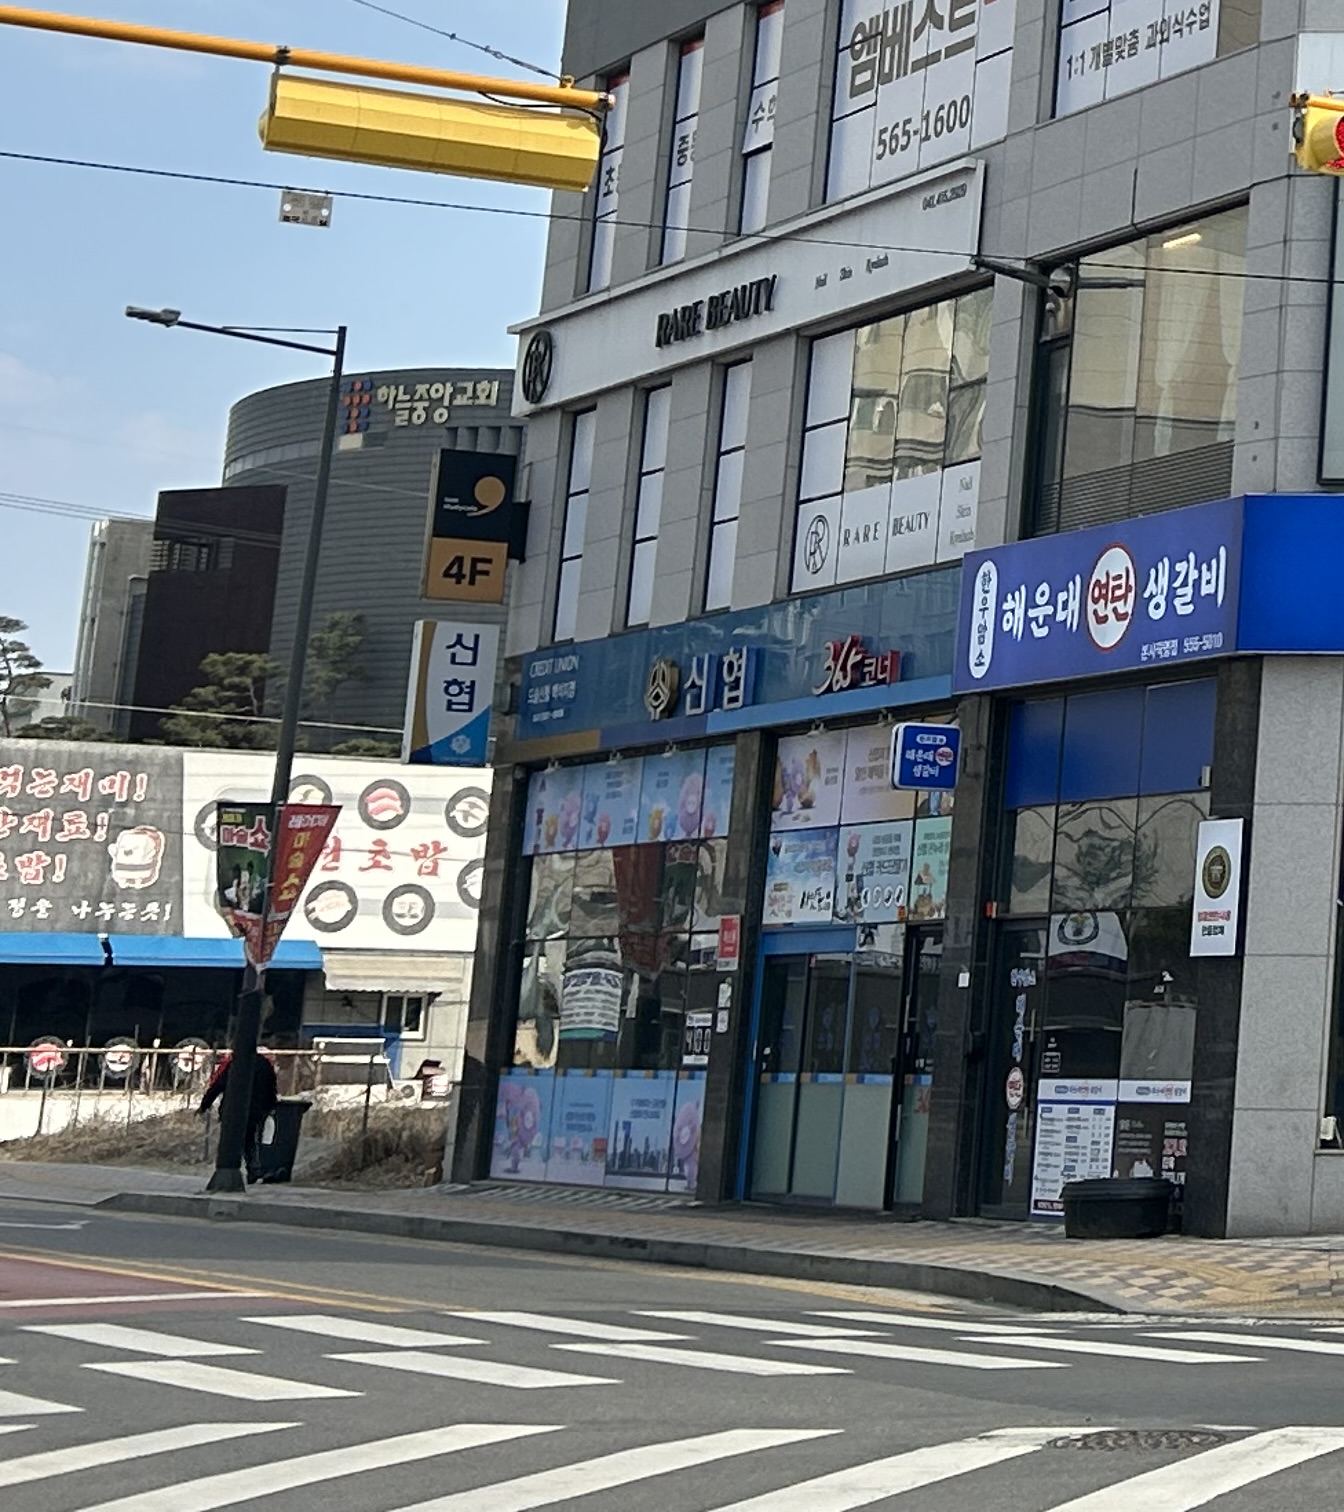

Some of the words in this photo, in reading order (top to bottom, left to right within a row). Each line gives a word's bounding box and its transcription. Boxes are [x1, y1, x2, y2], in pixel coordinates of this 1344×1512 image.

[1089, 28, 1140, 71] 개별맞춤
[1144, 0, 1212, 50] 과외식수업
[876, 94, 971, 161] 565-1600
[655, 299, 704, 348] RARE
[705, 274, 778, 332] BEAUTY
[377, 380, 500, 426] 하늘중앙교회
[842, 521, 881, 547] RARE
[892, 511, 930, 537] BEAUTY
[441, 556, 493, 587] 4F
[973, 570, 994, 668] 한우암소
[1001, 573, 1082, 642] 해운대
[1090, 567, 1133, 625] 연탄
[1143, 545, 1227, 621] 생갈비
[444, 632, 480, 713] 신협
[684, 645, 749, 717] 신협
[862, 651, 892, 687] 코너
